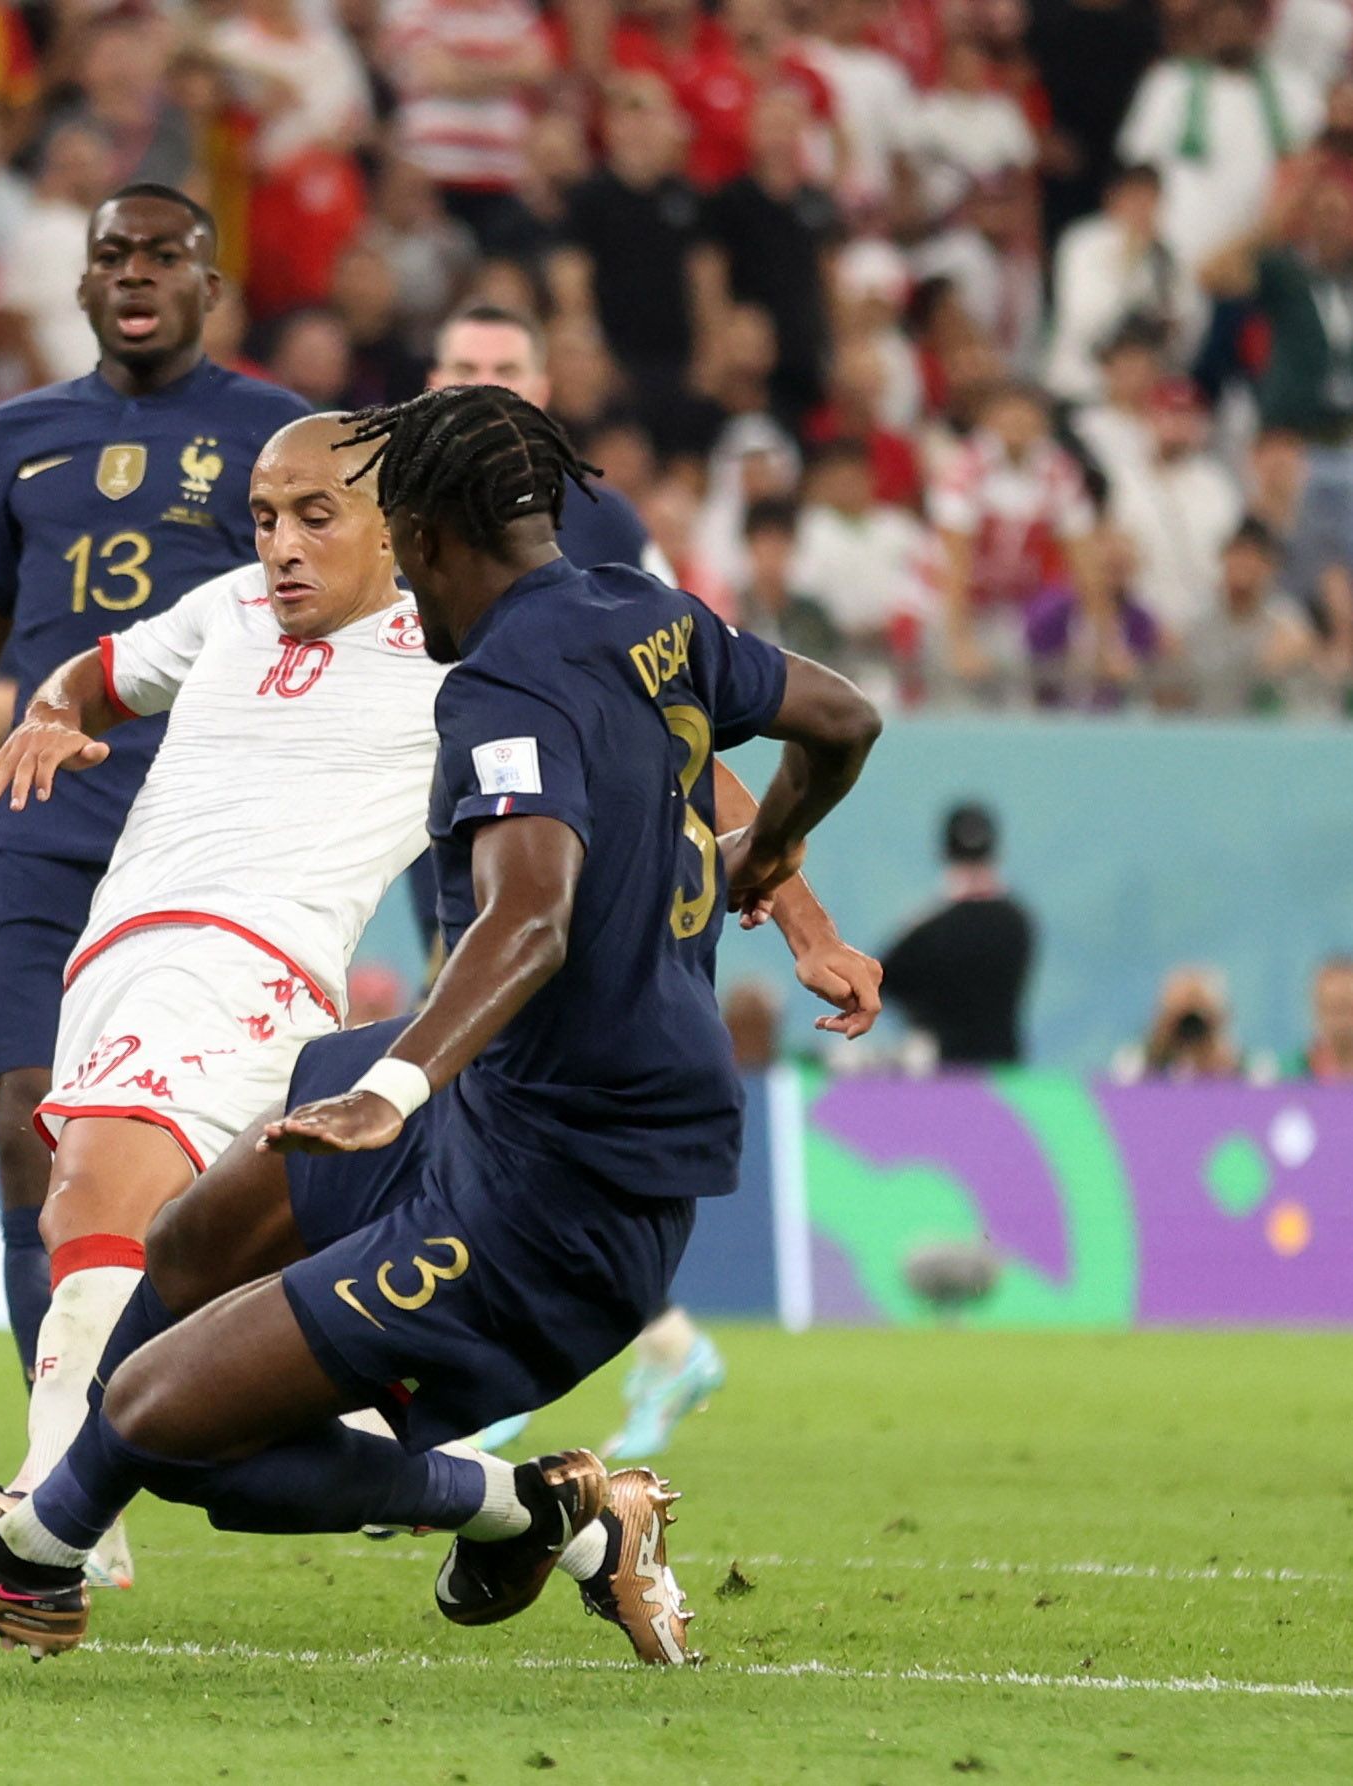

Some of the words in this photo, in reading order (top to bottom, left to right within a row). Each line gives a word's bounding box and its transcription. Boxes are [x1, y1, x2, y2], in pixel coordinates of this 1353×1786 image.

[63, 531, 152, 613] 13
[257, 634, 334, 698] 10
[376, 1236, 470, 1310] 3
